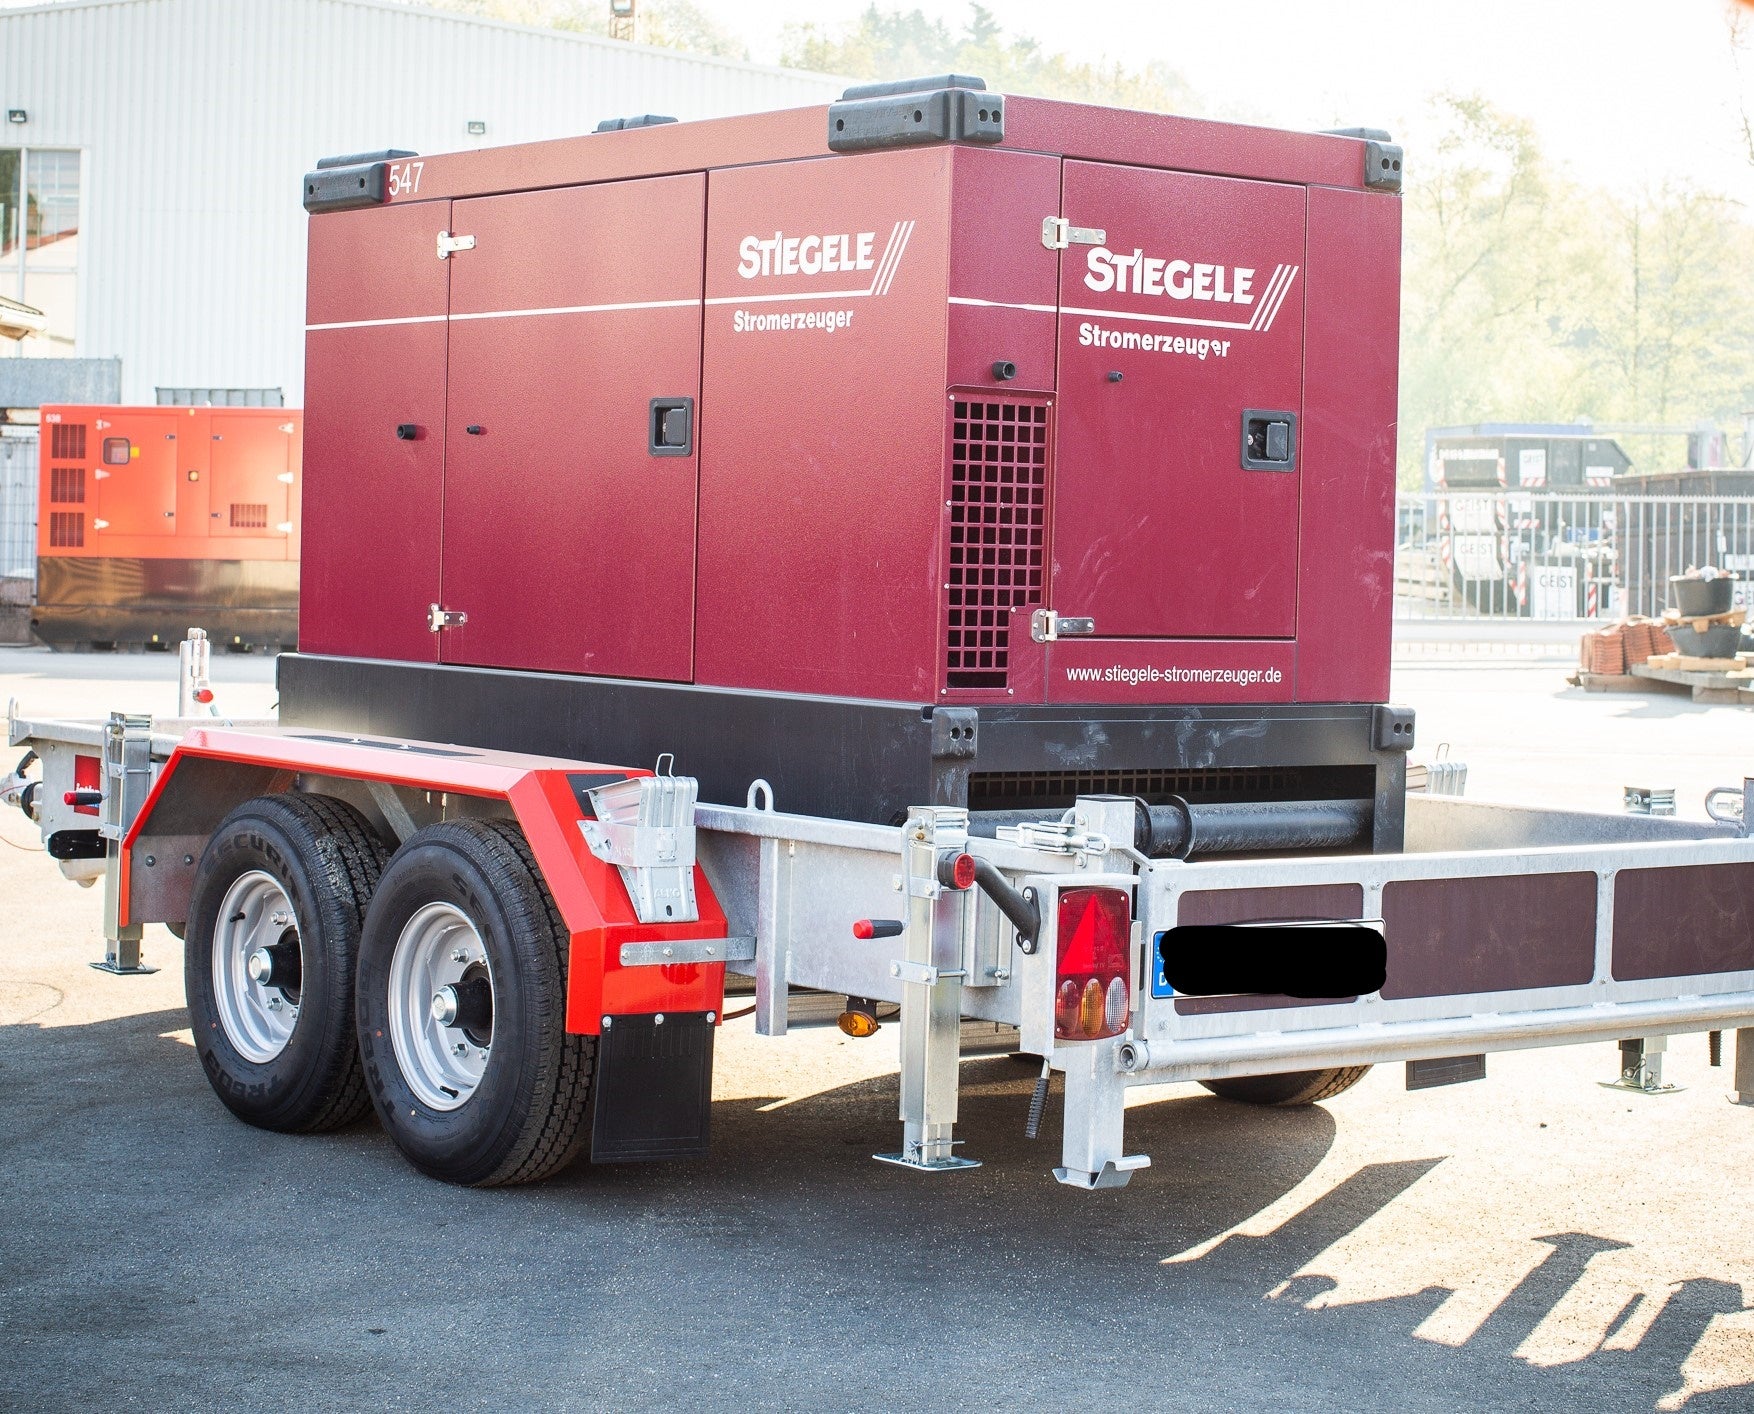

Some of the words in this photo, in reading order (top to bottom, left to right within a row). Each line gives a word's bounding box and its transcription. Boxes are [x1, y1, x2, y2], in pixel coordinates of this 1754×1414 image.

[389, 161, 425, 196] 547
[738, 231, 876, 279] STIEGELE
[1084, 247, 1256, 305] STIEGELE
[733, 310, 854, 333] Stromerzeuger
[1079, 322, 1231, 361] Stromerzeuger
[1539, 574, 1574, 588] GEIST
[1066, 664, 1282, 687] www.stiegele-stromerzeuger.de
